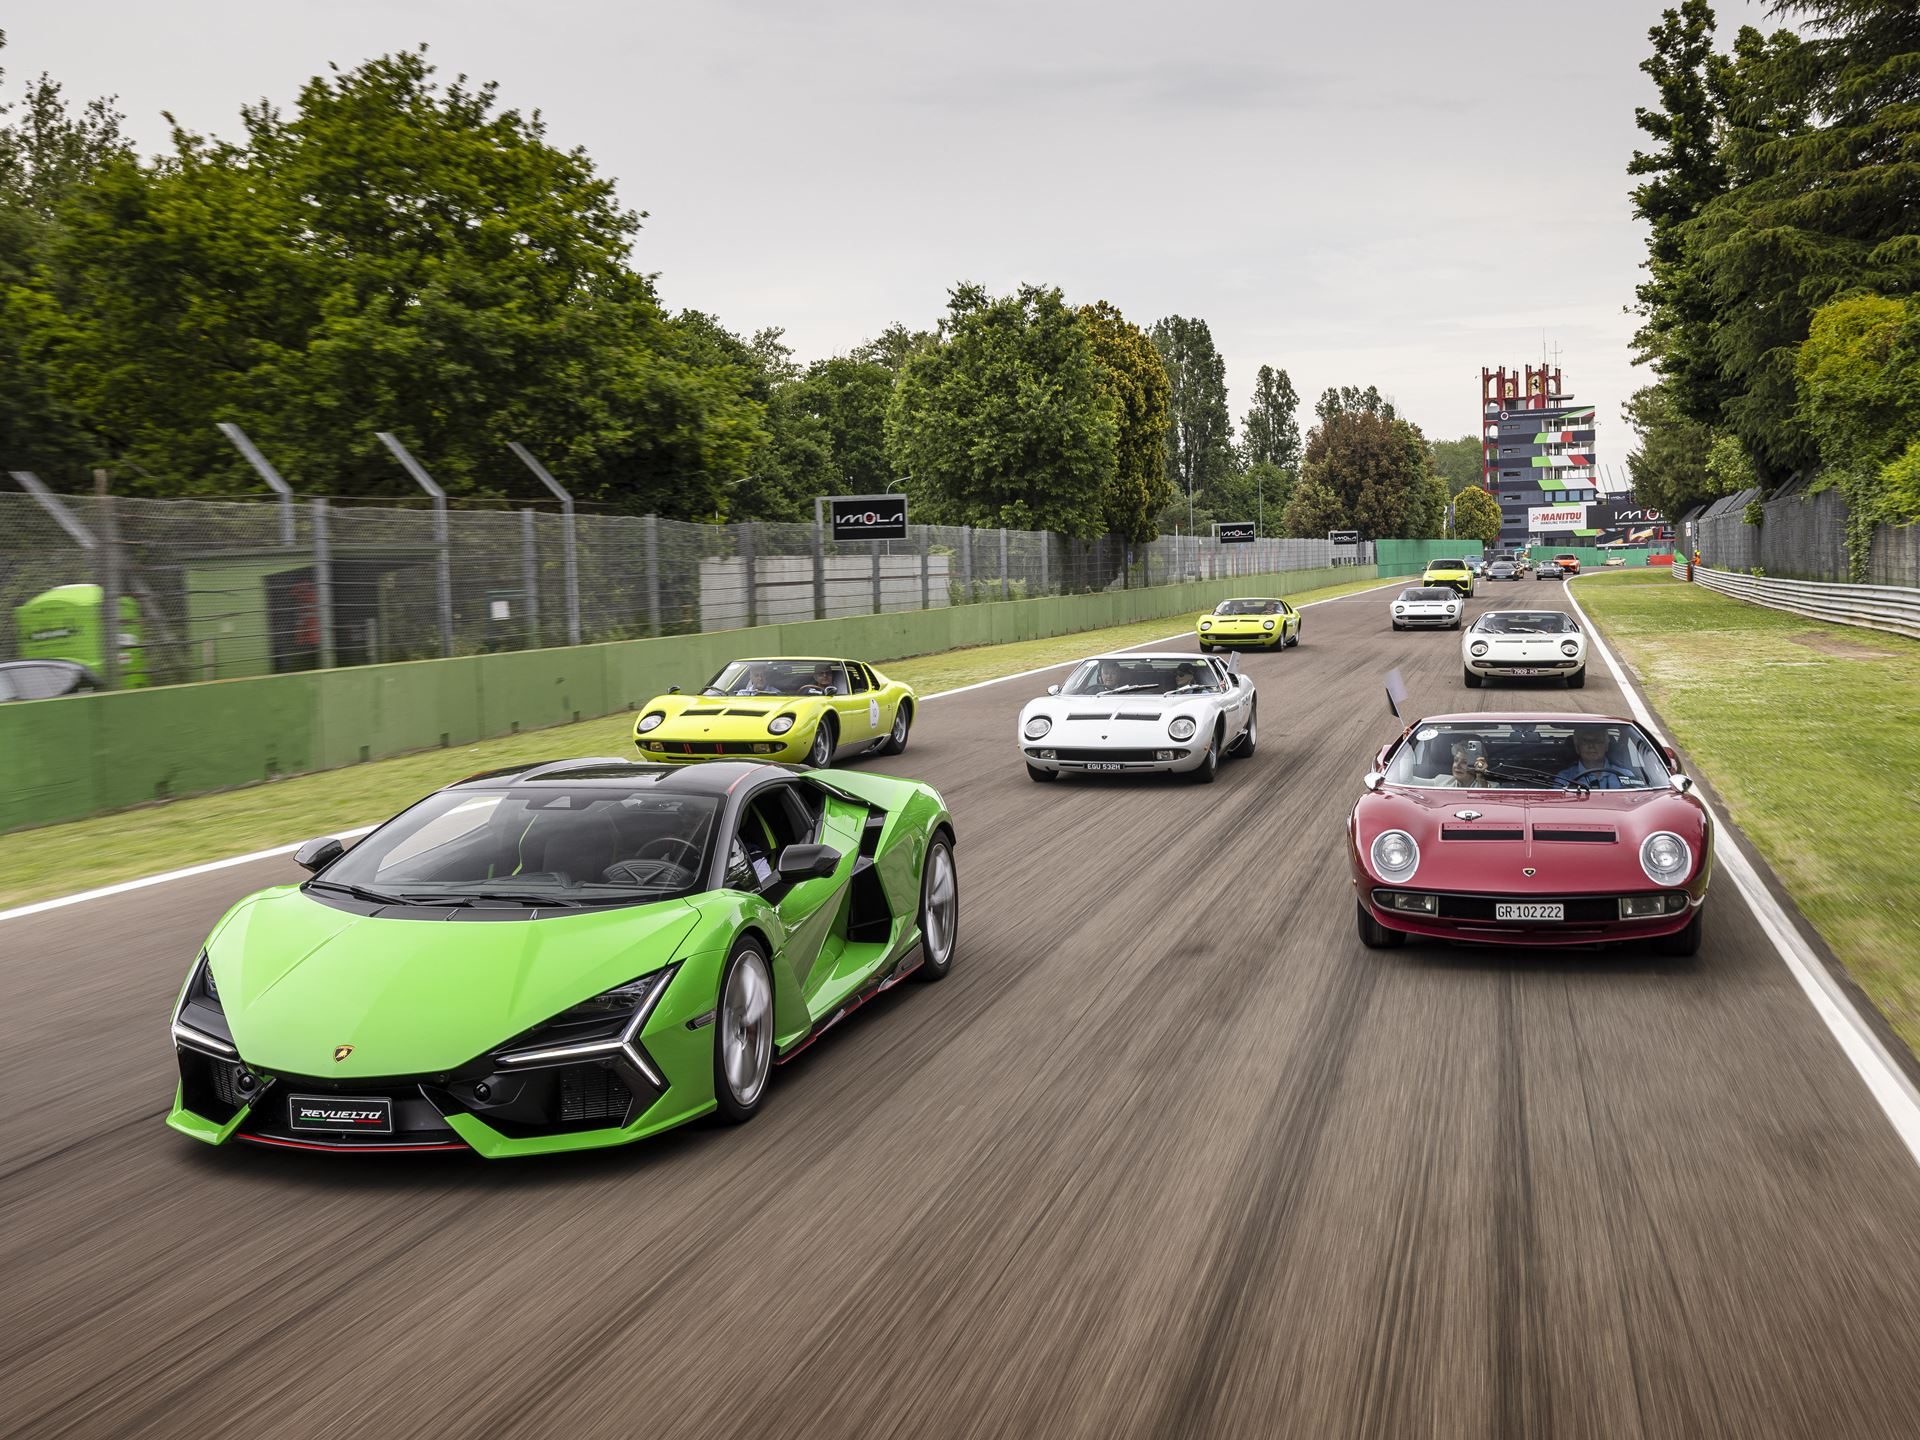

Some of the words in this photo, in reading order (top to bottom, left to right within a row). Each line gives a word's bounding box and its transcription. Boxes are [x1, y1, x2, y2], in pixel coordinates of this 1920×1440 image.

[835, 511, 903, 525] IMOLA
[1541, 512, 1582, 521] MANITOU
[300, 1107, 382, 1120] REVUELTO
